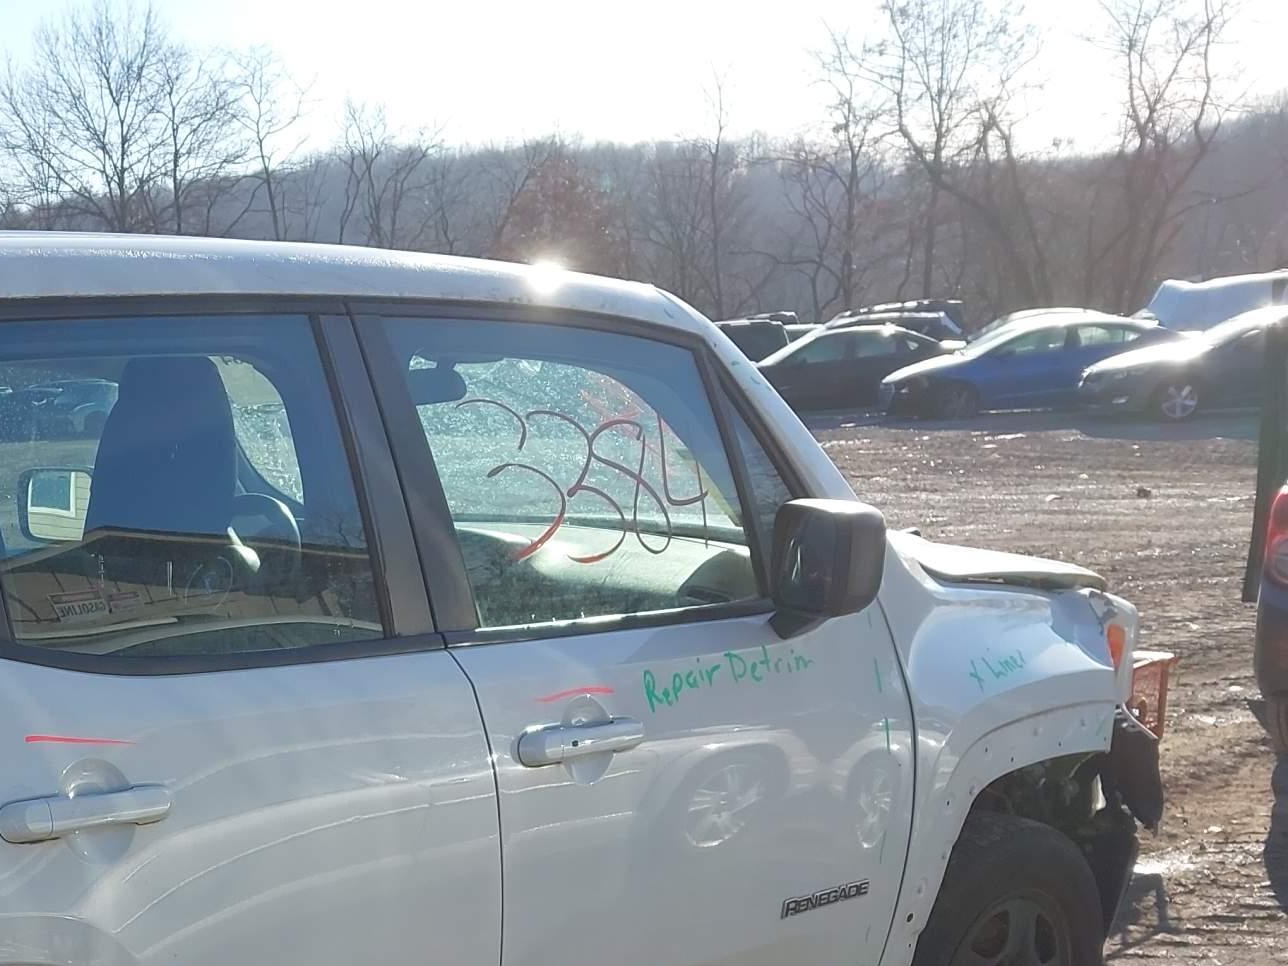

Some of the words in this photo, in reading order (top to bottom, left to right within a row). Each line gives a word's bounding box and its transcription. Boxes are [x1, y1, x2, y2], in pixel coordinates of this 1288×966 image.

[455, 398, 708, 564] 3384
[642, 657, 721, 713] Repair
[780, 878, 871, 920] RENEGADE
